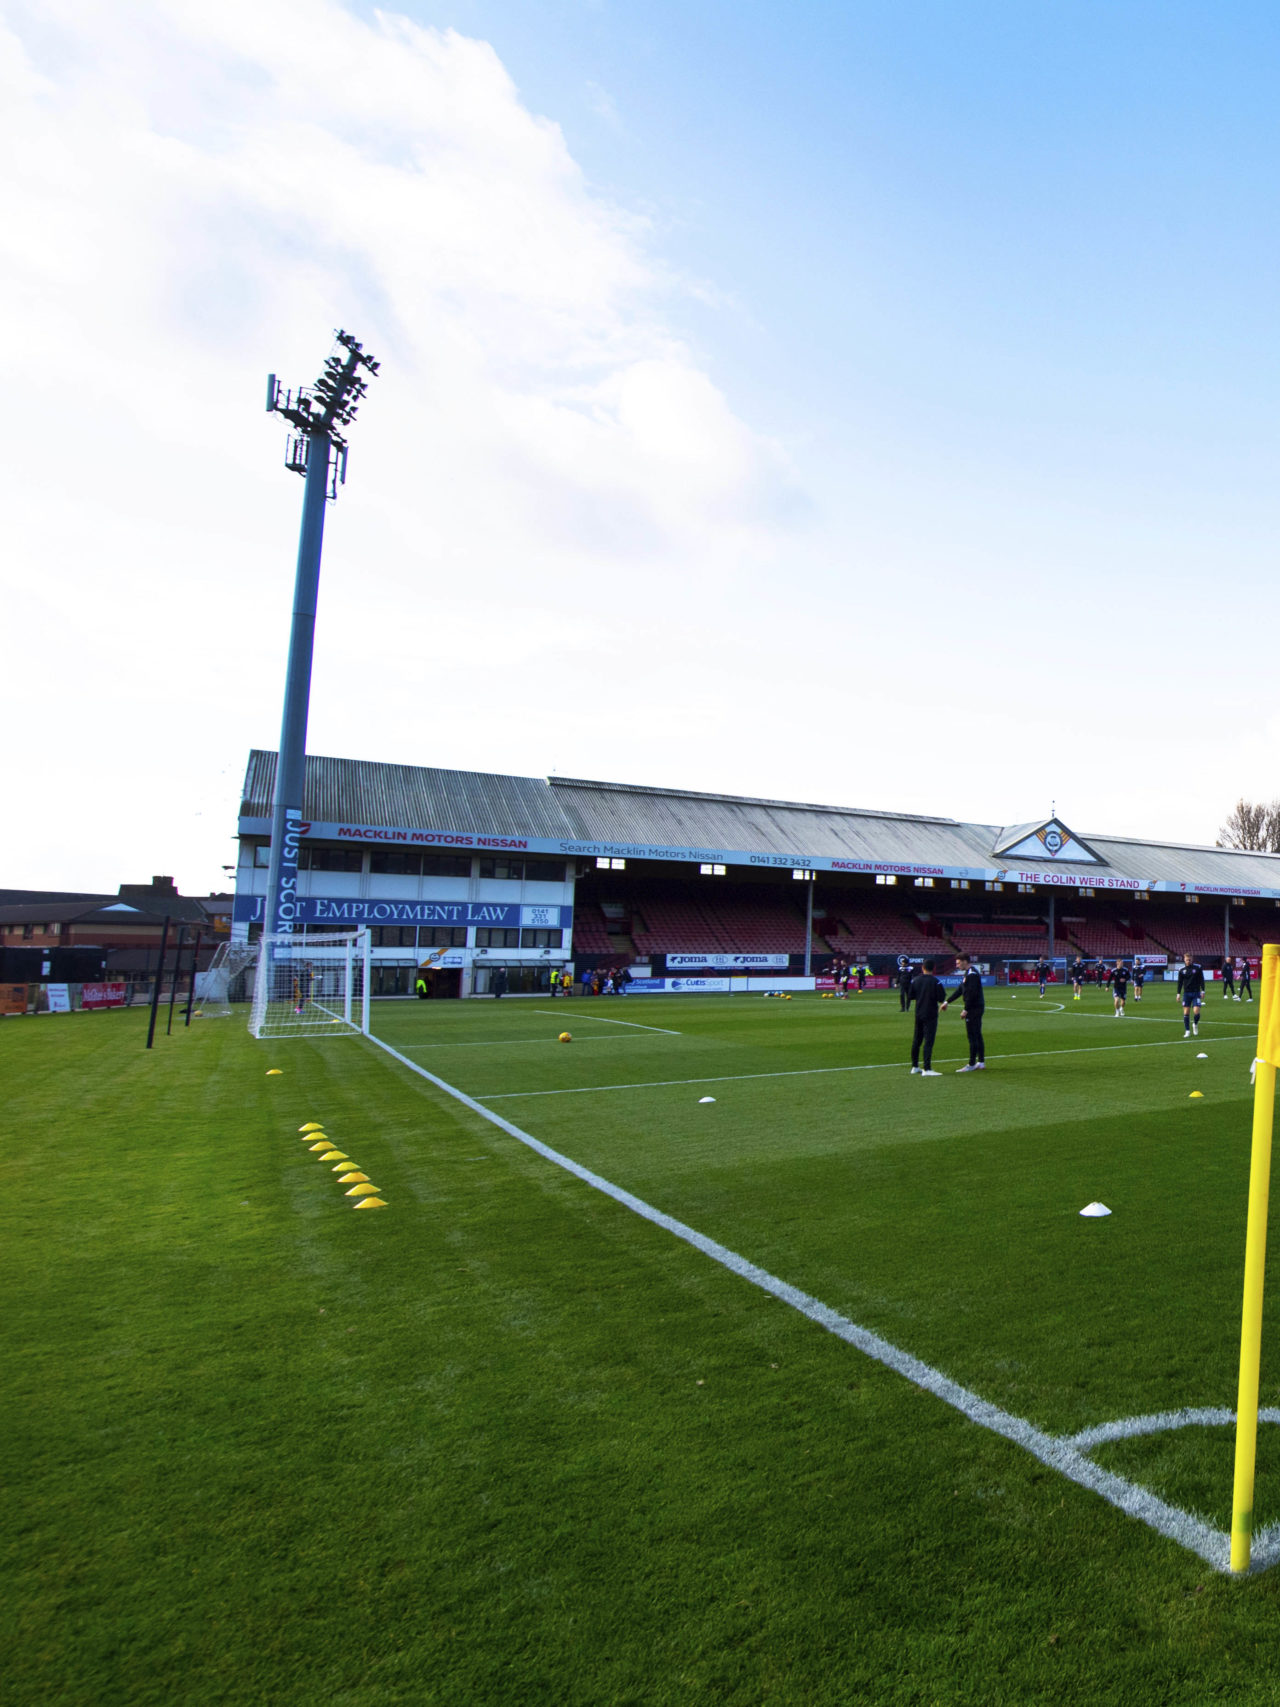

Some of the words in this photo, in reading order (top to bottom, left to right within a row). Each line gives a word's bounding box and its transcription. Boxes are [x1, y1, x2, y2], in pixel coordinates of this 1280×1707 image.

[283, 820, 301, 866] JUST
[338, 827, 408, 841] MACKLIN
[411, 832, 474, 845] MOTORS
[477, 837, 528, 849] NISSAN
[559, 842, 601, 854] Search
[604, 845, 646, 857] Macklin
[649, 848, 687, 859] Motors
[689, 851, 723, 861] Nissan
[750, 855, 770, 864] 0141
[771, 856, 788, 865] 332
[789, 857, 811, 867] 3432
[831, 861, 873, 871] MACKLIN
[874, 863, 911, 873] MOTORS
[913, 866, 944, 875] NISSAN
[1018, 872, 1041, 883] THE
[1043, 874, 1076, 885] COLIN
[1079, 877, 1105, 887] WEIR
[1107, 879, 1140, 889] STAND
[251, 897, 306, 920] JT
